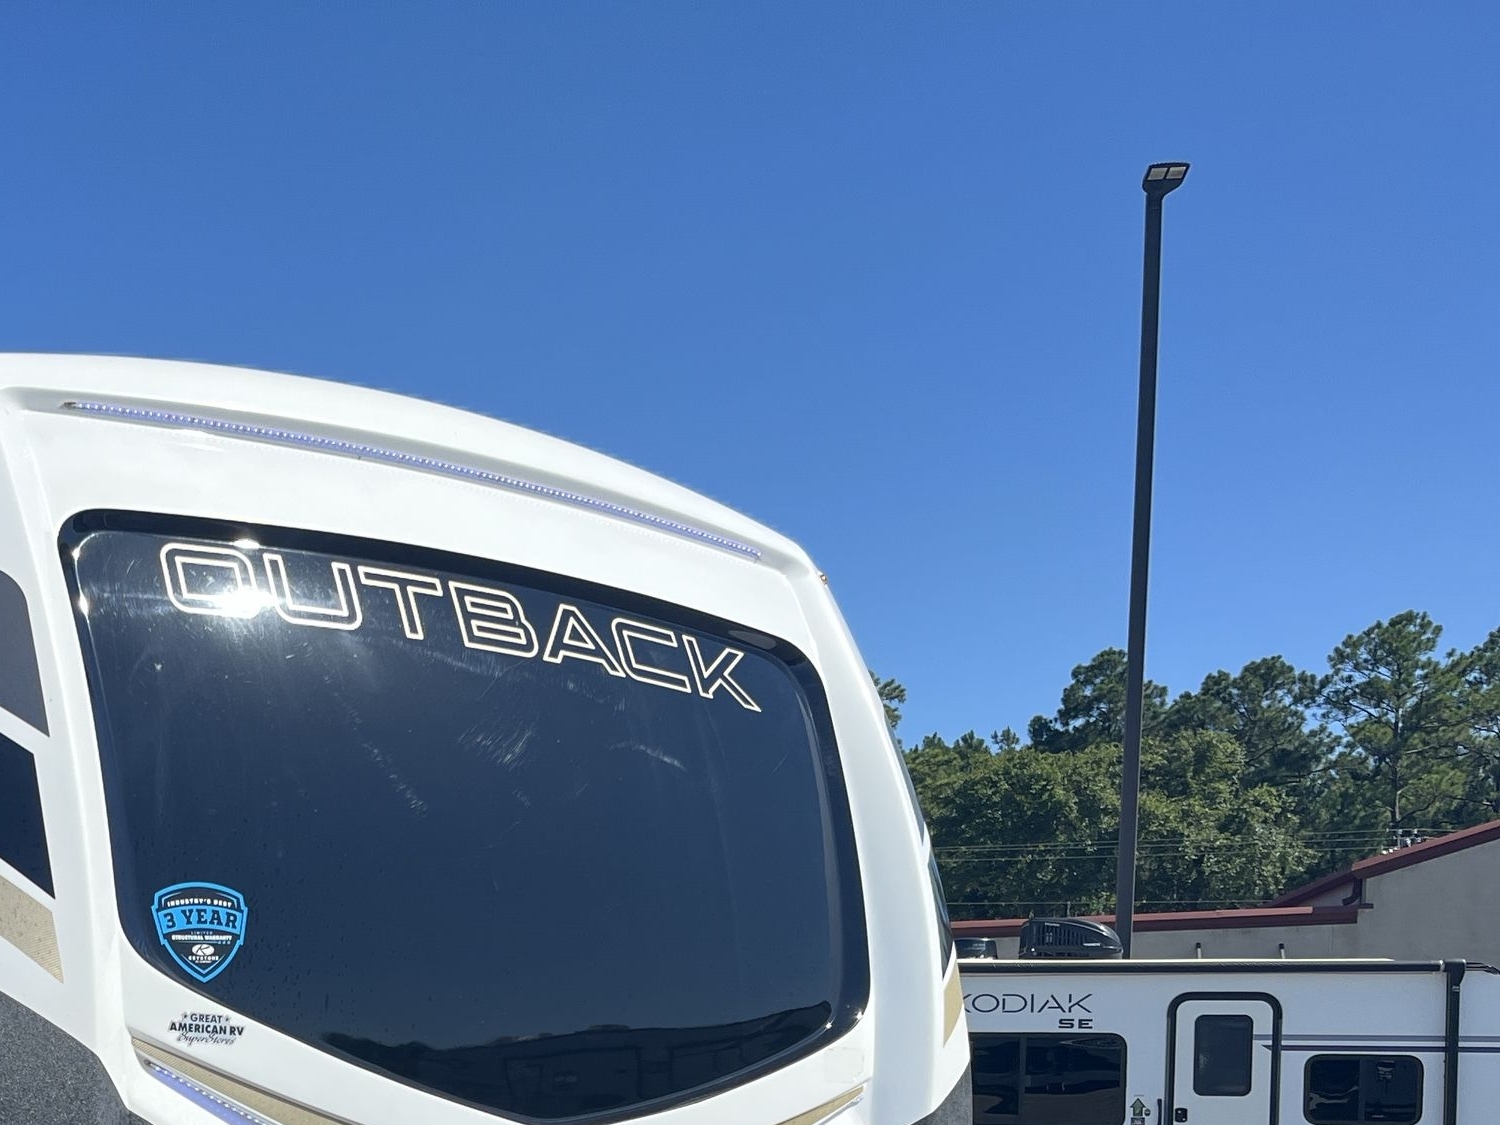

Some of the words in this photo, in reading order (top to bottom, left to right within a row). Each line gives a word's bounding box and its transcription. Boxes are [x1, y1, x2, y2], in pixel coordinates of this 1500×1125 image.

[160, 541, 762, 713] OUTBACK
[163, 912, 176, 929] 3
[181, 908, 238, 930] YEAR
[190, 1012, 223, 1024] GREAT
[1058, 1018, 1093, 1030] SE
[169, 1022, 227, 1035] AMERICAN
[229, 1026, 245, 1036] RV
